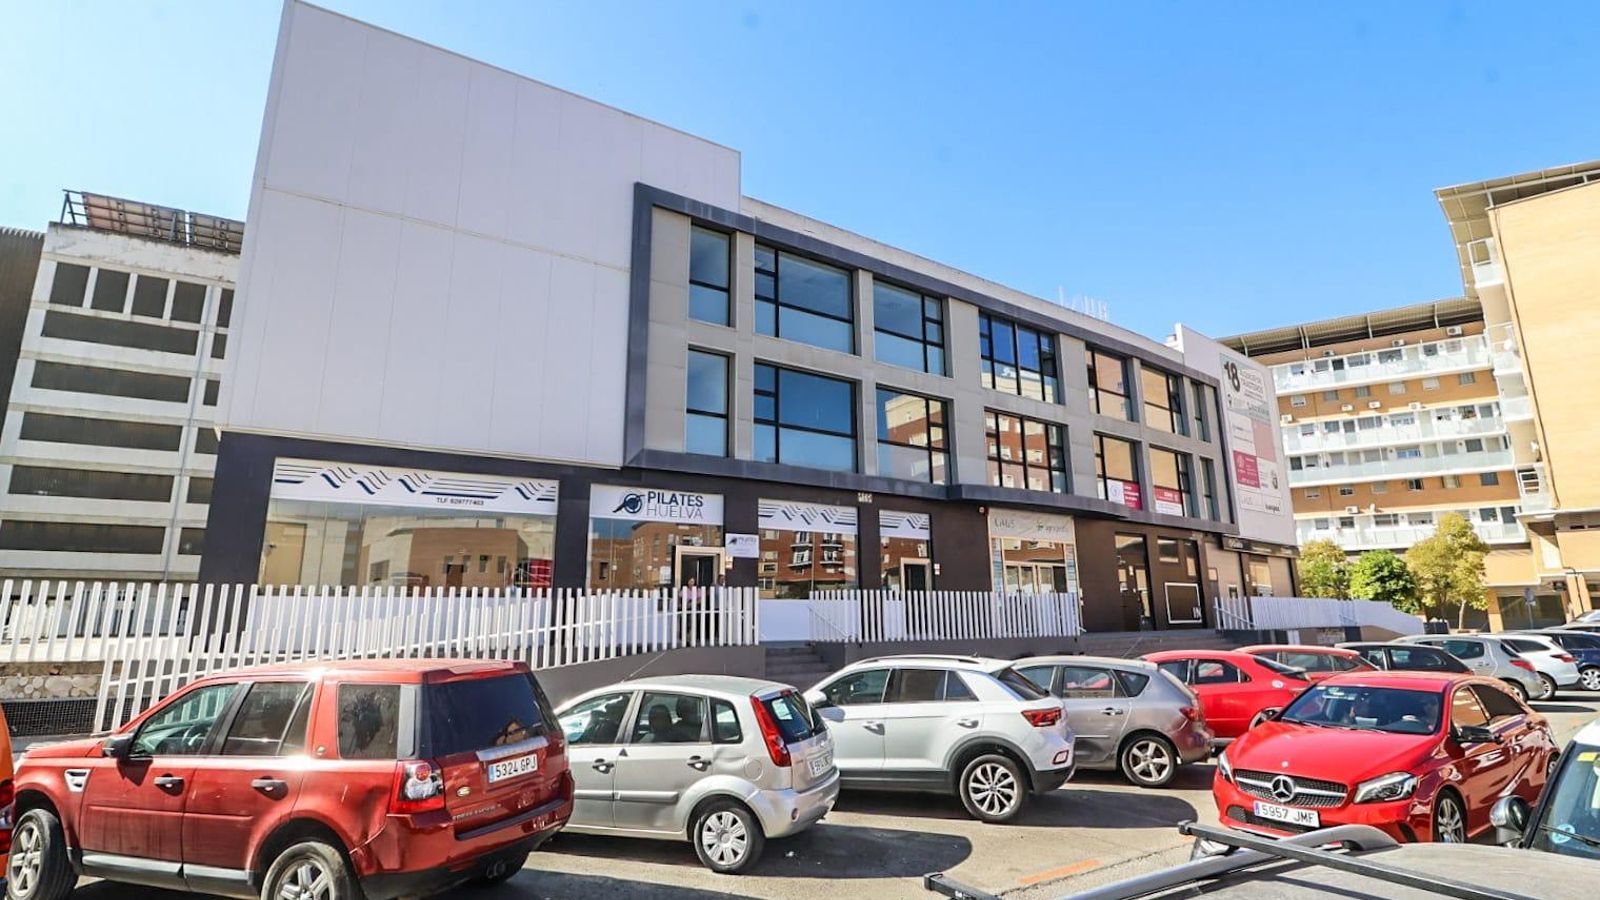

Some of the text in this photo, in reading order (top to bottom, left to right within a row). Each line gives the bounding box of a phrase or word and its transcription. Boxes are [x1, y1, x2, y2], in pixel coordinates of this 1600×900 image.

[1223, 361, 1240, 392] 18
[647, 491, 704, 508] PILATES
[646, 505, 704, 520] HUELVA
[495, 756, 537, 778] 5324 GPJ
[1261, 804, 1315, 823] 5957 JMF
